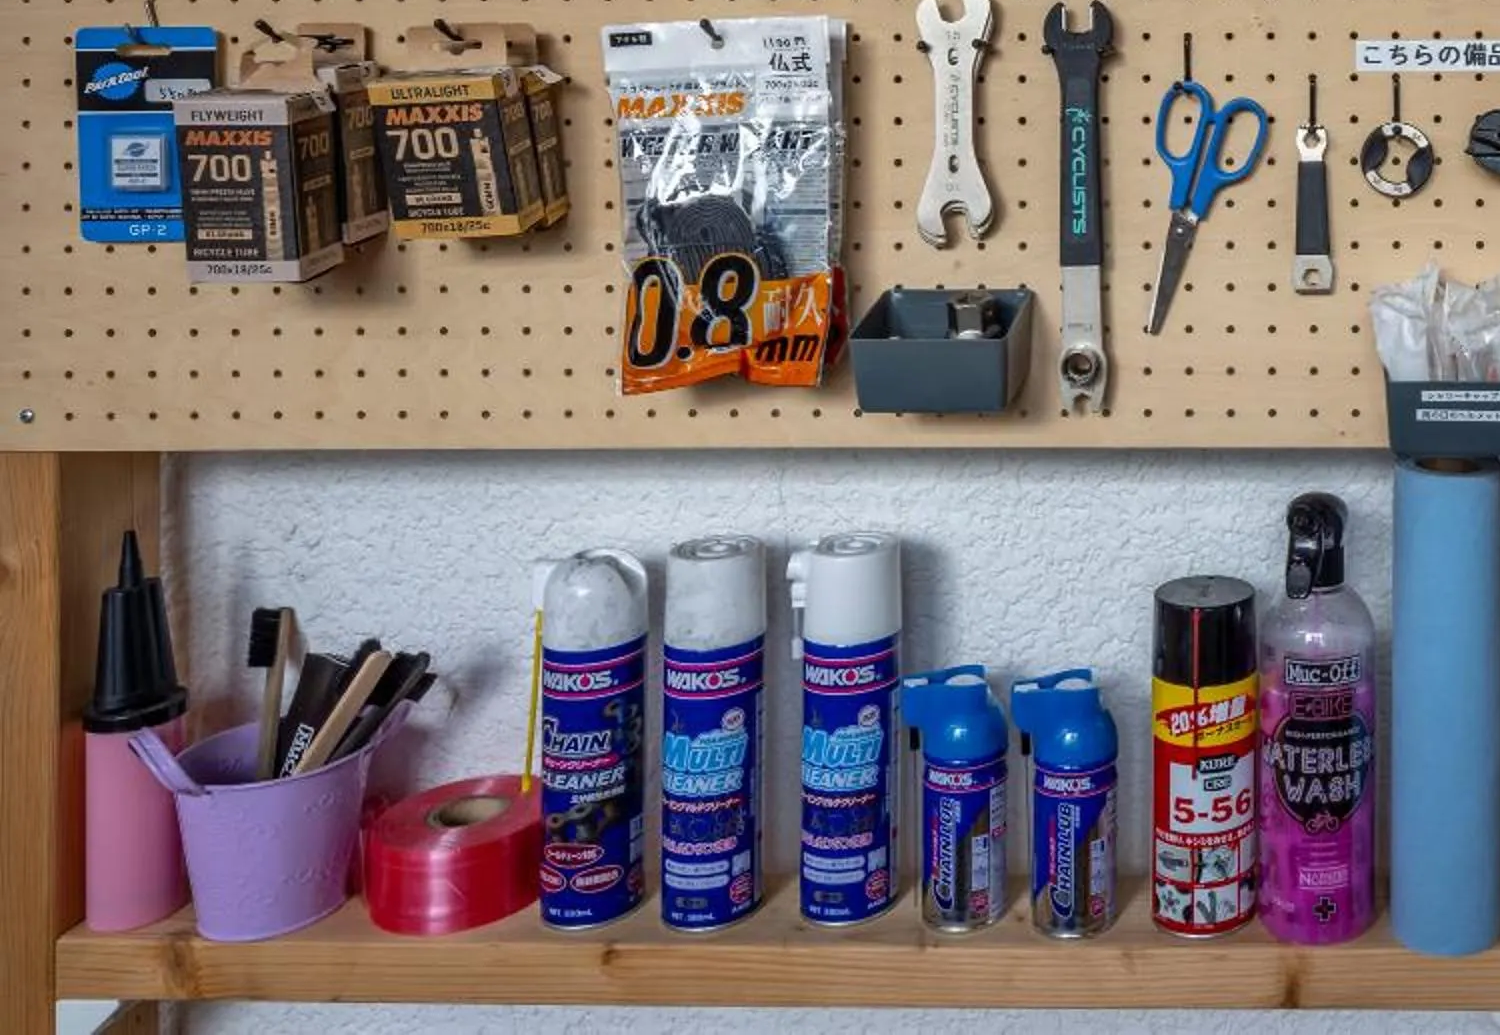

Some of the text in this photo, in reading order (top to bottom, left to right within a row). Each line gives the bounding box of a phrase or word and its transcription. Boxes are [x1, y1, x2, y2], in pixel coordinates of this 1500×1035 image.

[769, 52, 813, 72] 仏式
[391, 84, 470, 100] ULTRALIGHT
[190, 109, 264, 122] FLYWEIGHT
[385, 102, 484, 126] MAXXIS
[185, 129, 274, 146] MAXXIS
[385, 126, 460, 161] 700
[187, 153, 251, 183] 700
[1071, 125, 1087, 235] CYCLISTS
[129, 224, 168, 236] GP-2
[628, 253, 760, 369] 0.8
[763, 285, 823, 336] 耐久
[755, 334, 820, 362] mm
[1288, 662, 1360, 683] Muc-Off
[543, 716, 612, 758] CHAIN
[1284, 771, 1362, 805] WASH
[1173, 788, 1251, 825] 5-56
